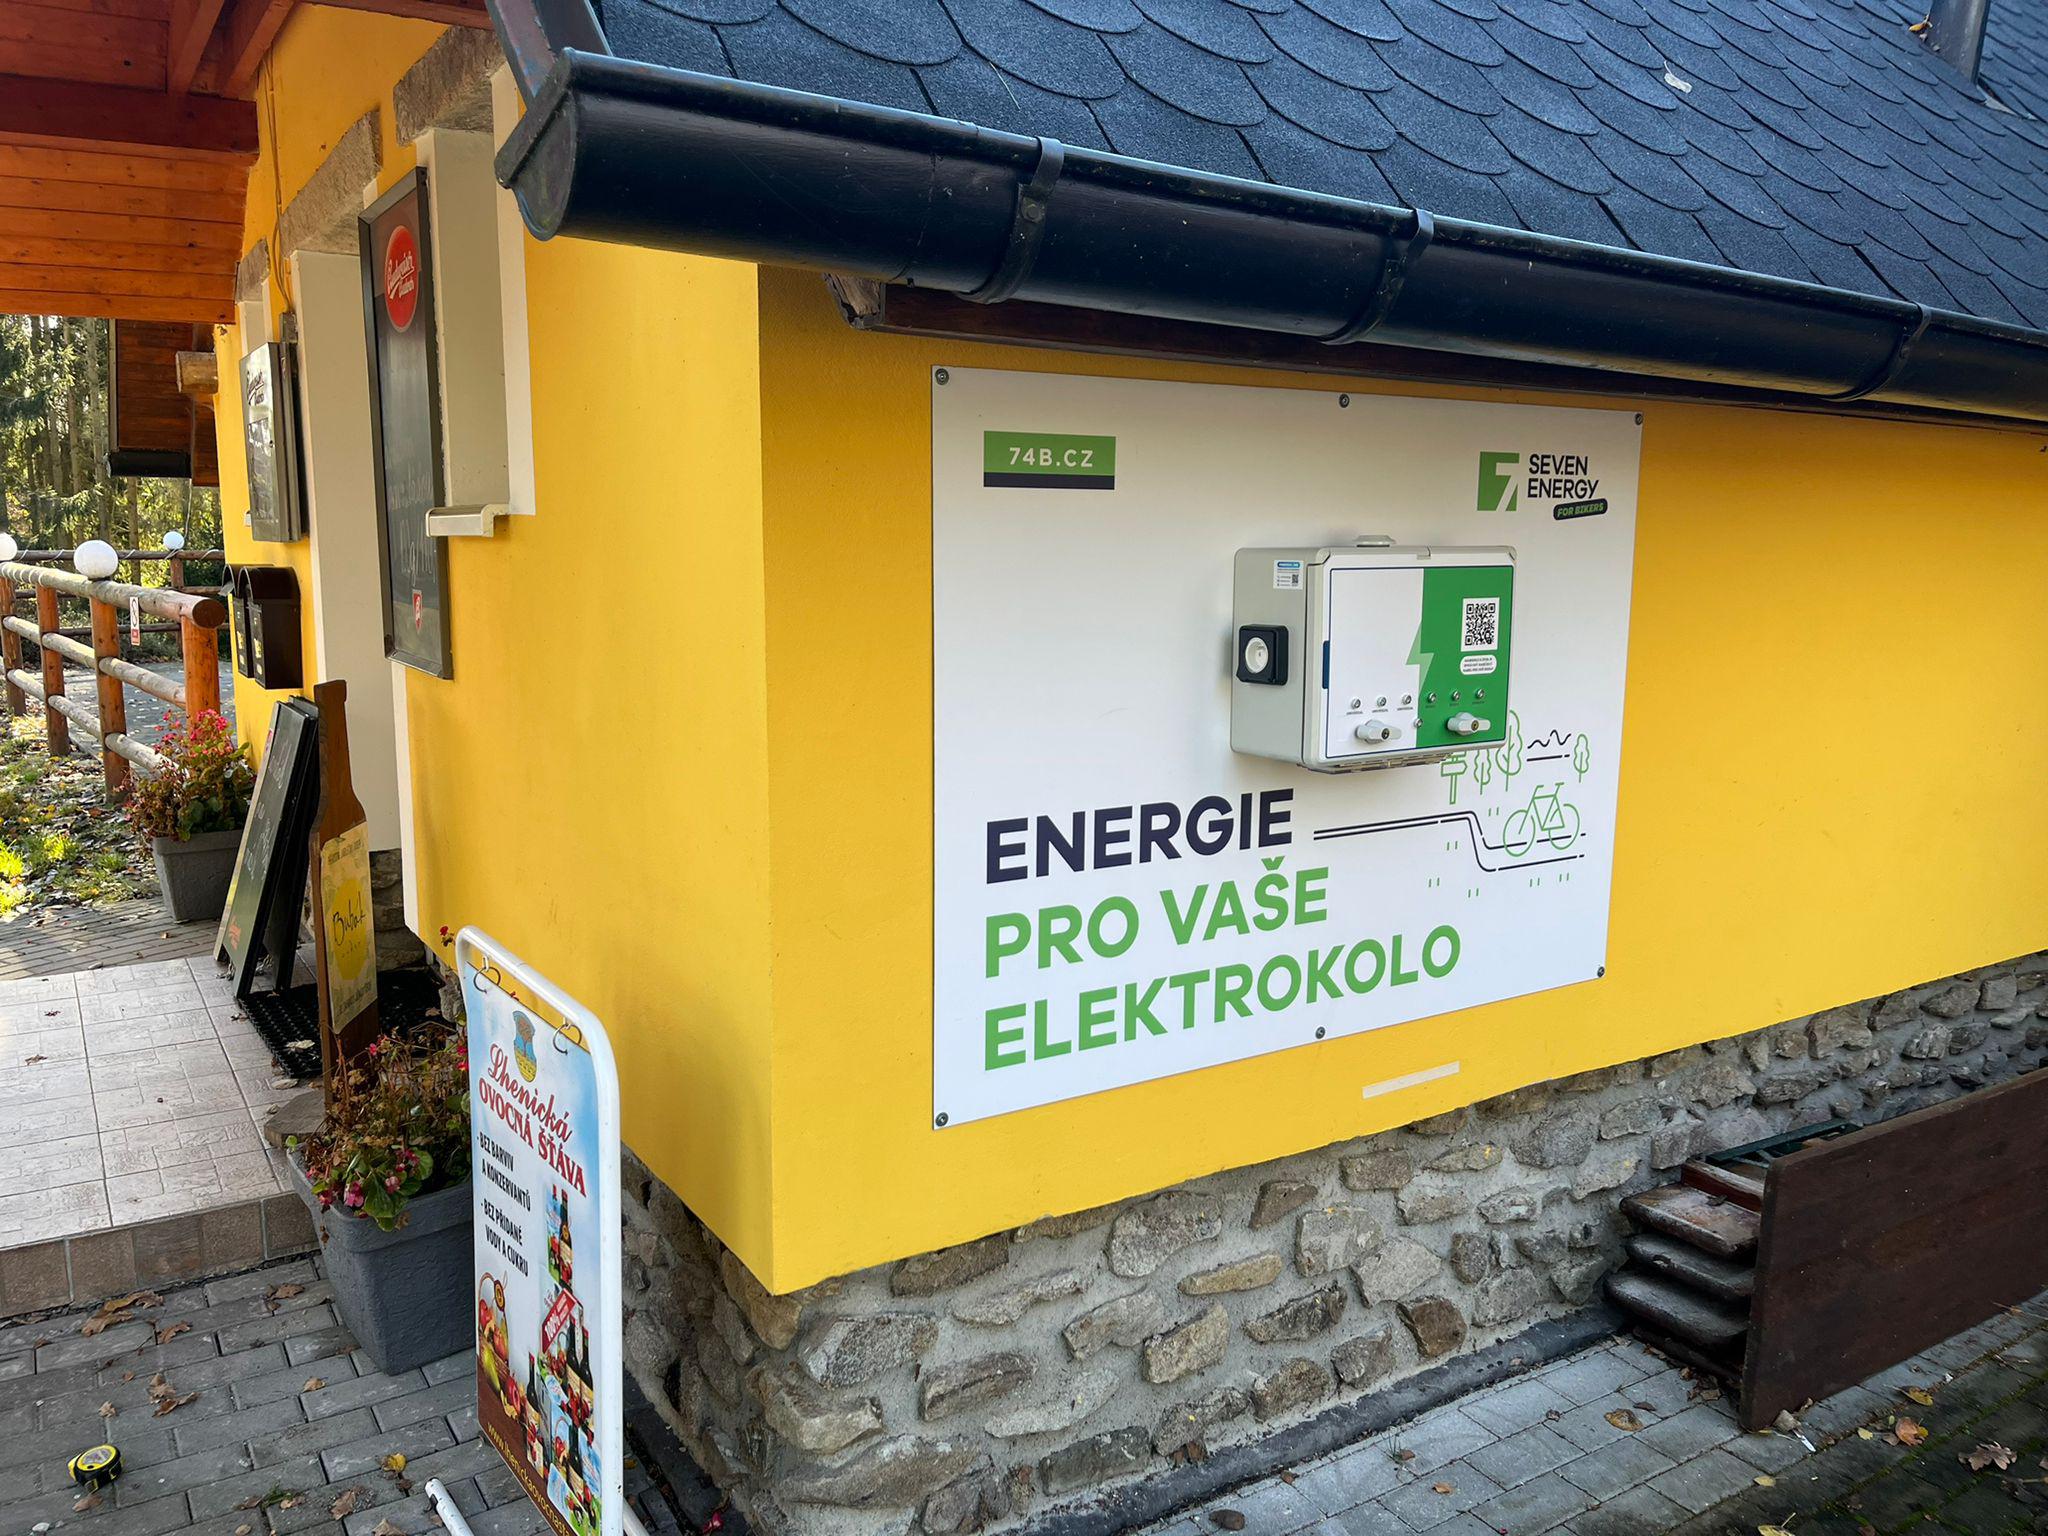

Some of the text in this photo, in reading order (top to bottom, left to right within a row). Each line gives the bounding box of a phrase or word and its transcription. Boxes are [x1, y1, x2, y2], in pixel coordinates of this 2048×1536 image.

[1009, 447, 1094, 467] 74B.CZ
[1527, 478, 1600, 499] ENERGY
[1557, 502, 1604, 518] FOR BIKERS
[986, 788, 1294, 884] ENERGIE
[985, 855, 1329, 978] PRO VAŠE
[985, 925, 1461, 1071] ELEKTROKOLO
[488, 1043, 573, 1143] Lhenická
[479, 1077, 587, 1198] OVOCNÁ ŠŤÁVA
[491, 1140, 514, 1172] BARVIV
[482, 1158, 531, 1212] A KONZERVANTŮ
[485, 1224, 501, 1253] VODY
[502, 1240, 507, 1258] A
[507, 1244, 529, 1278] CUKRU
[495, 1208, 523, 1247] PŘIDANÉ
